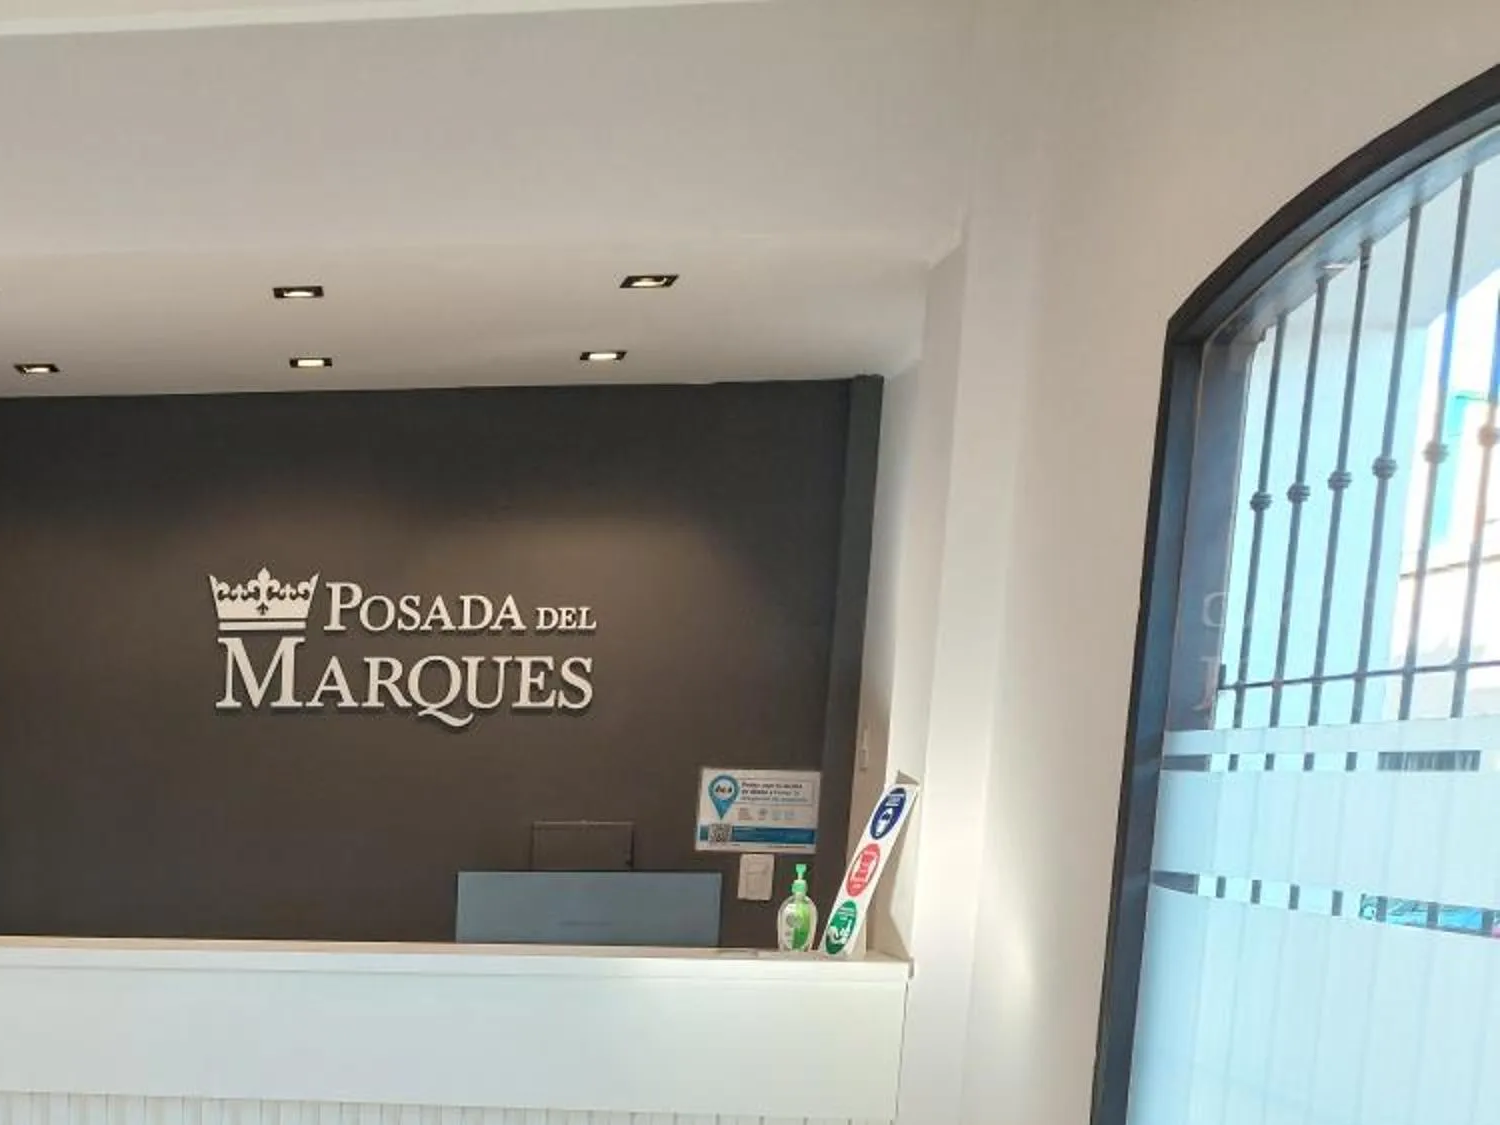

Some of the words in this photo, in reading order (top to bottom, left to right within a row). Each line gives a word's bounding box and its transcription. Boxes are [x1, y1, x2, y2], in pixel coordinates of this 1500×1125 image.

[323, 581, 527, 632] POSADA
[535, 606, 597, 631] DEL
[216, 636, 593, 728] MARQUES
